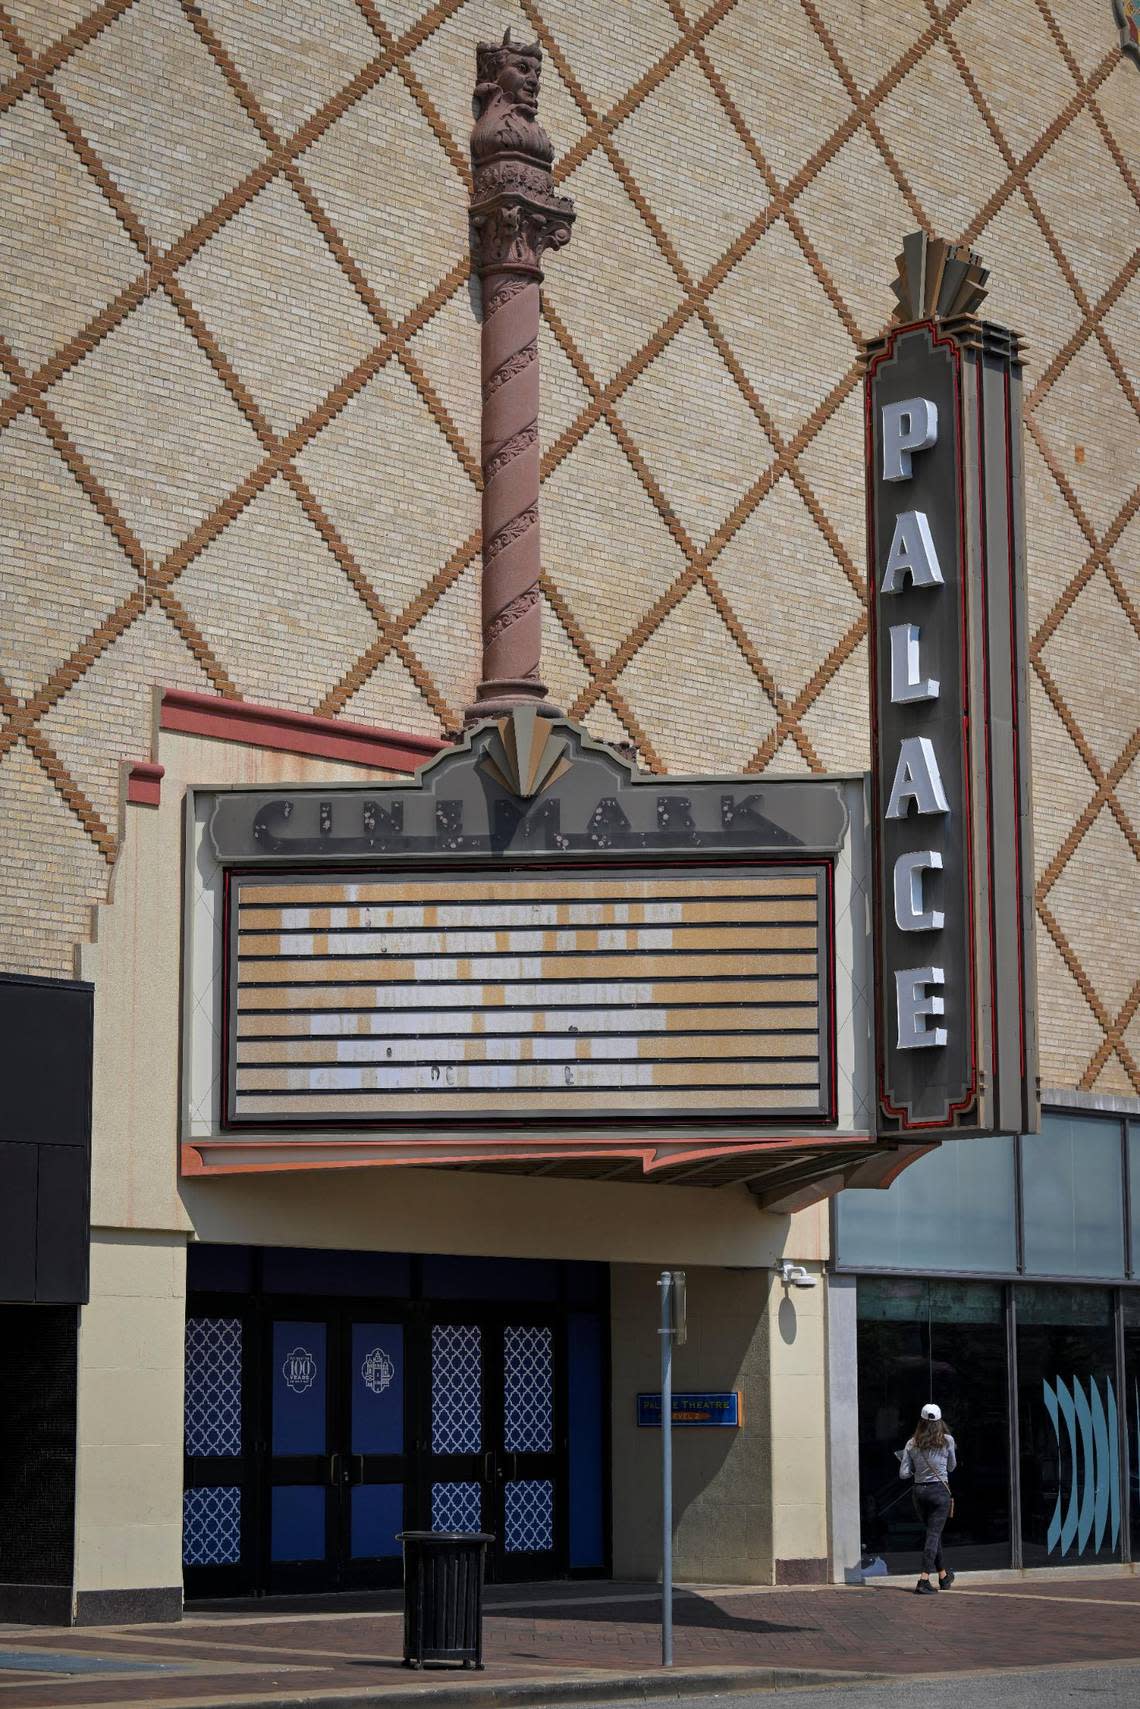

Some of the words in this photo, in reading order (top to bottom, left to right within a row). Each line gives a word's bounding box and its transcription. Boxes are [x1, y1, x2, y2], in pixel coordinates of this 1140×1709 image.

[881, 397, 949, 1050] PALACE
[252, 794, 804, 852] CINEMARK
[290, 1360, 310, 1376] 100
[643, 1401, 679, 1409] PALE
[682, 1400, 730, 1409] THEATRE
